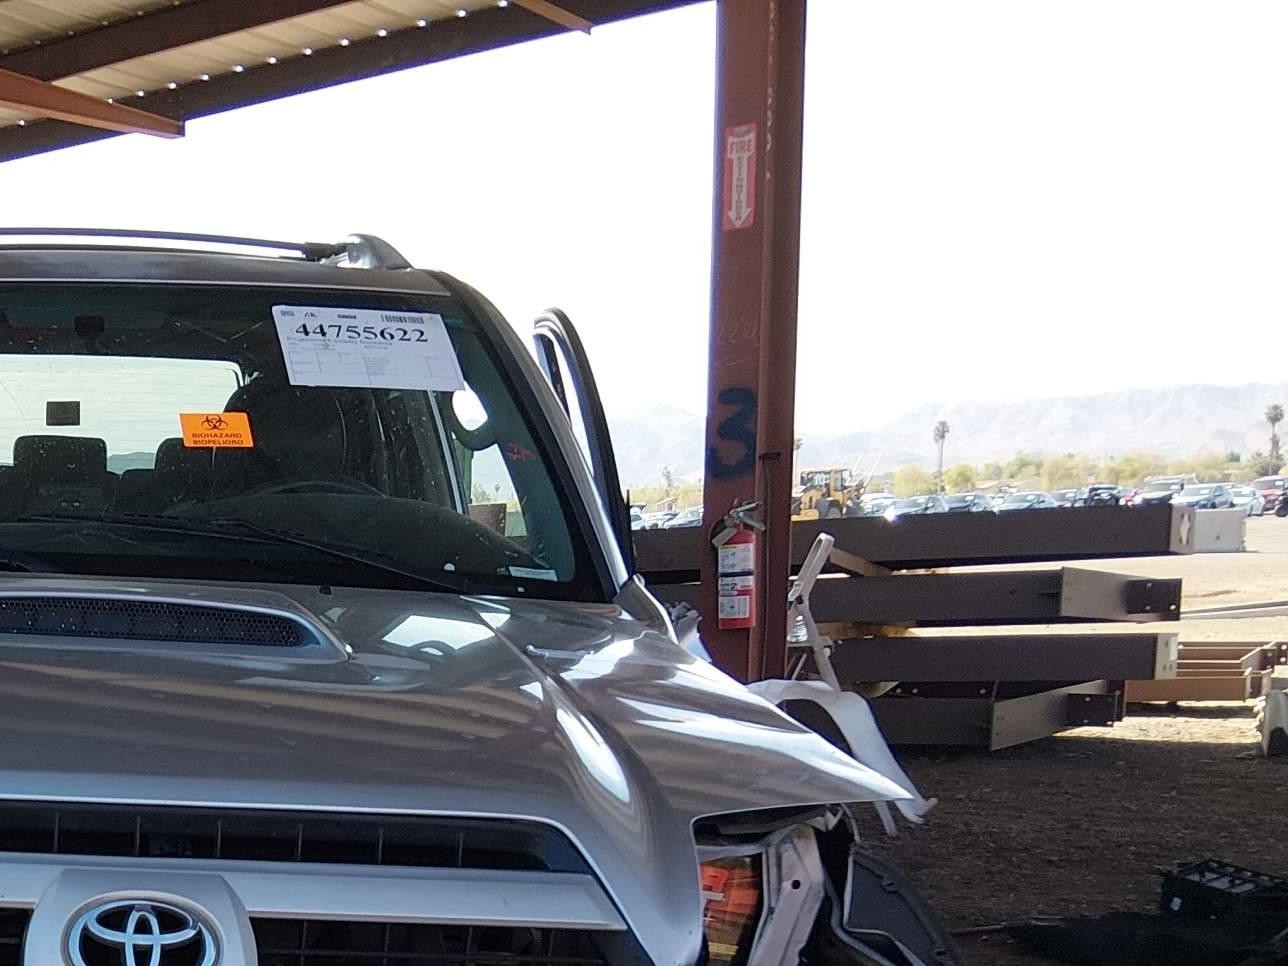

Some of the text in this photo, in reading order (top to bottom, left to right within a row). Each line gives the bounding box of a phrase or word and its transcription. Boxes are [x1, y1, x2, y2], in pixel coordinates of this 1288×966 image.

[729, 138, 753, 154] FIRE
[295, 322, 429, 343] 44755622
[705, 387, 757, 480] 3
